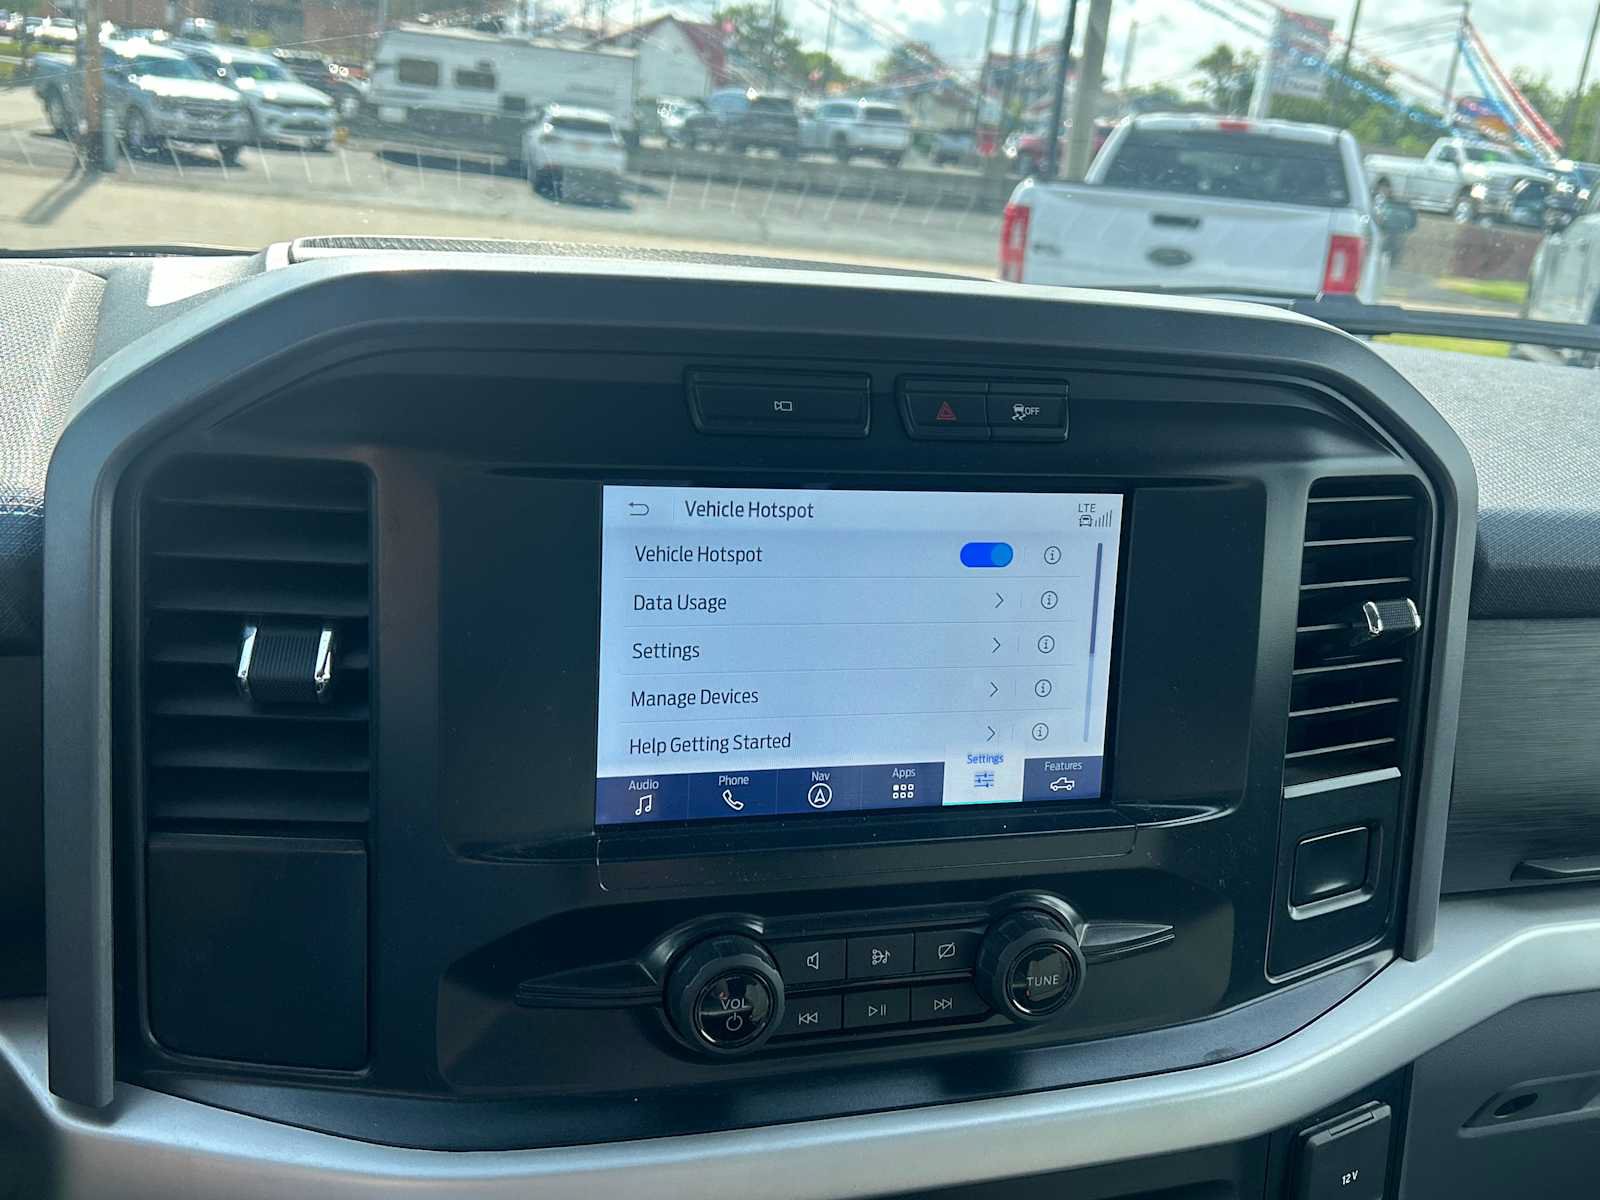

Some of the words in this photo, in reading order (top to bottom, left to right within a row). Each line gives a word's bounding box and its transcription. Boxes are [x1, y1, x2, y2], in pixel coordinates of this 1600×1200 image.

[1024, 406, 1040, 416] OFF
[685, 500, 745, 518] Vehicle
[748, 501, 814, 521] Hotspot
[1078, 503, 1097, 513] LTE
[635, 545, 693, 562] Vehicle
[698, 546, 763, 565] Hotspot
[633, 594, 673, 611] Data
[677, 594, 727, 614] Usage
[632, 642, 700, 661] Settings
[631, 690, 696, 709] Manage
[700, 688, 759, 705] Devices
[629, 738, 667, 757] Help
[670, 735, 729, 754] Getting
[733, 731, 792, 751] Started
[967, 753, 1005, 765] Settings
[1044, 760, 1083, 772] Features
[811, 771, 831, 782] Nav
[892, 767, 917, 780] Apps
[628, 779, 660, 791] Audio
[718, 775, 750, 786] Phone
[1026, 974, 1061, 987] TUNE
[721, 998, 748, 1010] VOL
[1342, 1169, 1359, 1185] 12V
